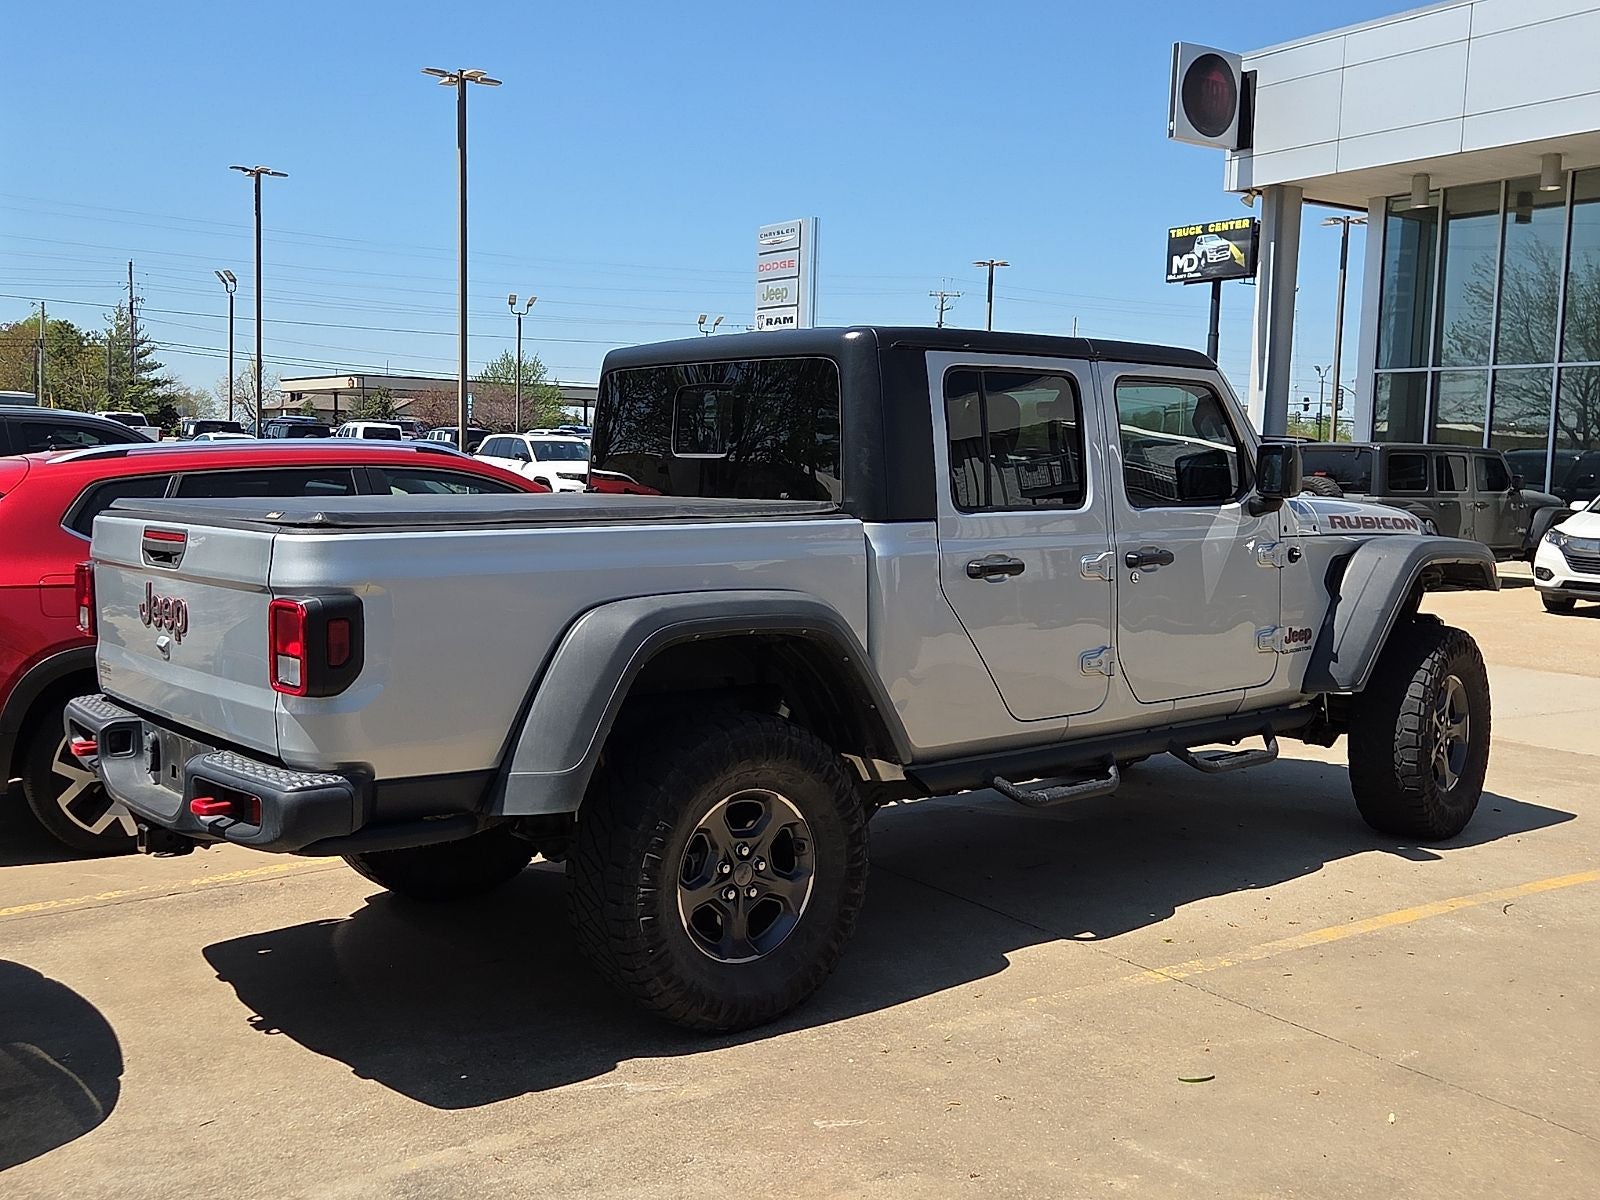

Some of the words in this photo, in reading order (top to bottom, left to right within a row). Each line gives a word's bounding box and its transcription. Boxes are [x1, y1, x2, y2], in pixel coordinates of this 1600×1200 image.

[759, 227, 796, 239] CHRYSLER
[1170, 225, 1203, 238] TRUCK
[1208, 219, 1250, 232] CENTER
[759, 260, 795, 272] DODGE
[1172, 254, 1199, 274] MD
[762, 285, 789, 303] Jeep
[765, 316, 794, 327] RAM
[1328, 515, 1418, 531] RUBICON
[139, 581, 189, 645] Jeep
[1284, 626, 1313, 645] Jeep
